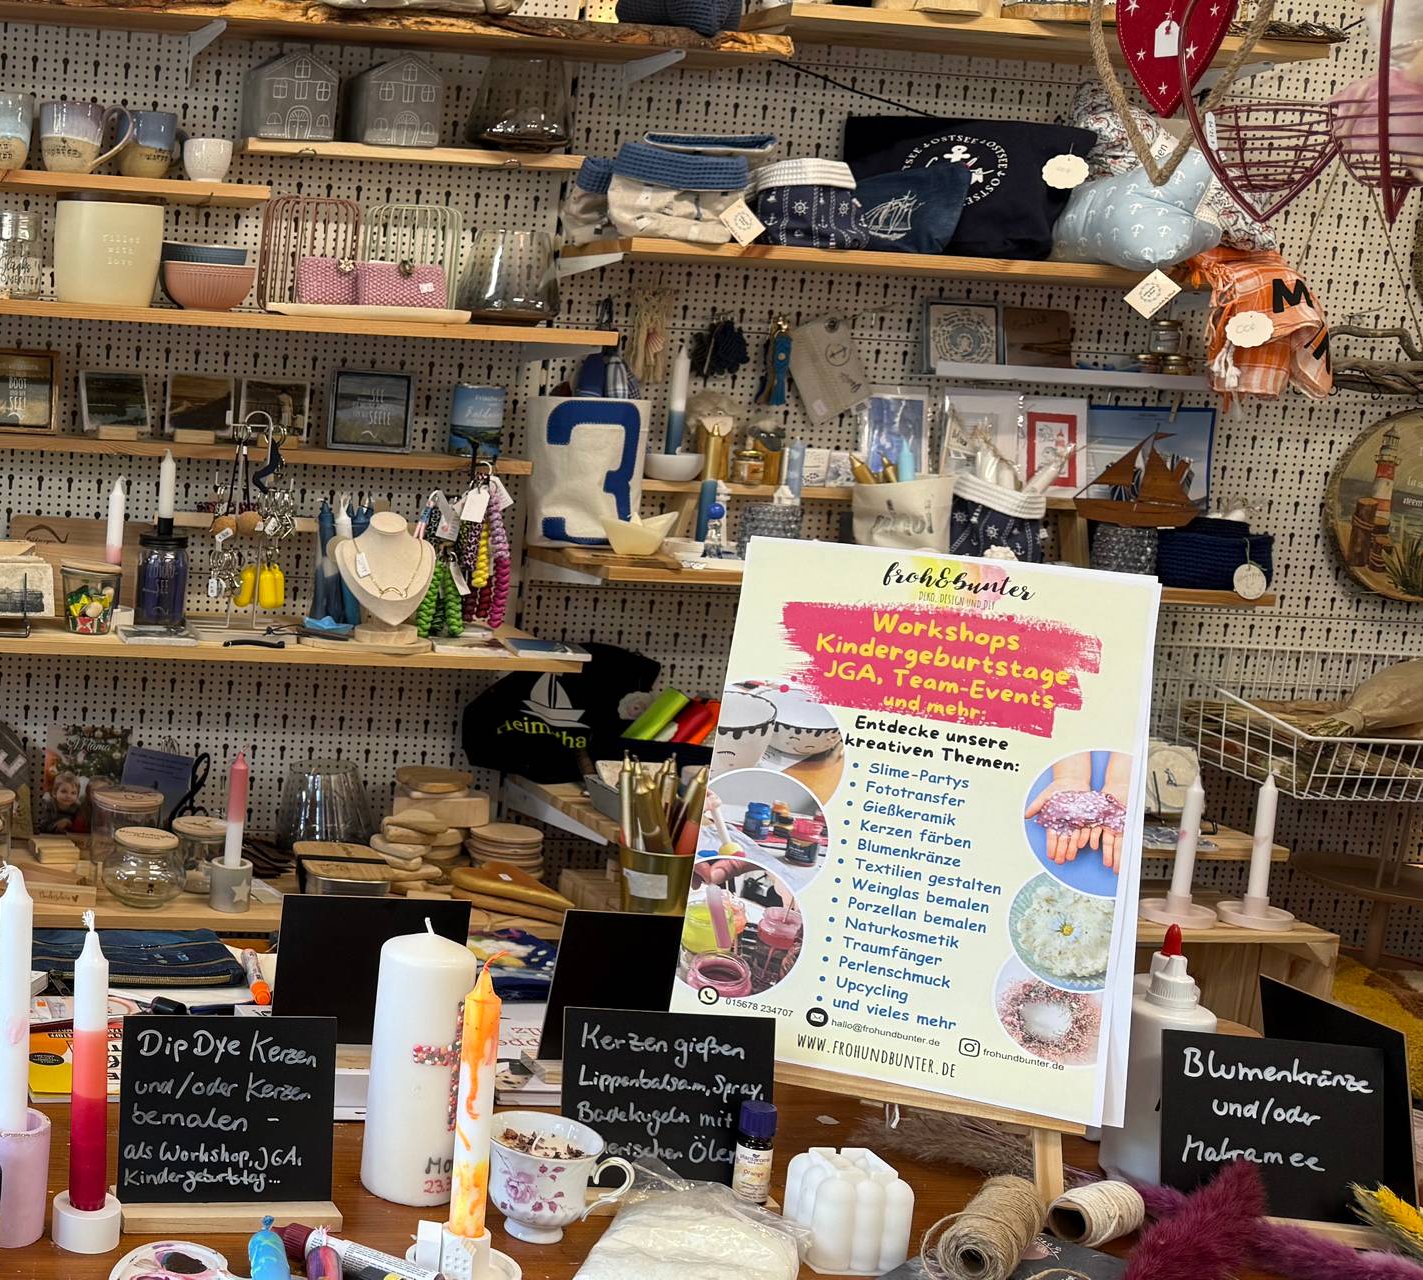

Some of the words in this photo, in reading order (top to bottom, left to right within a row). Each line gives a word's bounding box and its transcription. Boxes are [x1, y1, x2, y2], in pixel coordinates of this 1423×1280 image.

[930, 134, 979, 145] OSTSEE
[986, 141, 1009, 169] OSTSEE
[107, 257, 133, 265] love
[1272, 278, 1315, 313] M
[882, 561, 1036, 601] froh&bunter
[939, 593, 964, 605] DESIGN
[965, 597, 981, 609] UND
[982, 598, 995, 611] DIY
[873, 611, 1020, 655] Workshops
[816, 633, 1070, 690] Kindergeburtstage
[823, 660, 883, 685] JGA,
[893, 668, 1055, 710] Team-Events
[882, 694, 921, 713] und
[927, 702, 987, 720] mehr:
[496, 716, 587, 749] eimha
[854, 715, 940, 740] Entdecke
[946, 731, 1009, 751] unsere
[844, 733, 934, 759] kreativen
[942, 746, 1020, 773] Themen:
[868, 762, 970, 790] Slime-Partys
[865, 780, 966, 807] Fototransfer
[863, 800, 956, 826] Gießkeramik
[860, 819, 912, 839] Kerzen
[919, 829, 972, 849] färben
[857, 838, 961, 867] Blumenkränze
[854, 857, 922, 881] Textilien
[928, 873, 1002, 896] gestalten
[852, 876, 919, 900] Weinglas
[926, 891, 989, 914] bemalen
[848, 896, 917, 920] Porzellan
[923, 910, 987, 934] bemalen
[845, 916, 959, 949] Naturkosmetik
[843, 936, 943, 966] Traumfänger
[838, 955, 951, 989] Perlenschmuck
[836, 975, 909, 1004] Upcycling
[725, 997, 759, 1012] 015678
[760, 1003, 794, 1018] 234707
[832, 997, 860, 1012] und
[866, 1003, 910, 1022] vieles
[916, 1013, 957, 1031] mehr
[137, 1028, 187, 1063] Dip
[192, 1027, 241, 1064] Dye
[248, 1030, 317, 1068] Kerzen
[580, 1021, 669, 1055] Kerzen
[673, 1035, 745, 1069] gießen
[830, 1017, 941, 1047] hallo@frohundbunter.de
[796, 1033, 957, 1079] WWW.FROHUNDBUNTER.DE
[982, 1046, 1066, 1072] frohundbunter.de
[1183, 1046, 1374, 1094] Blumenkränze
[134, 1071, 239, 1098] und/oder
[245, 1072, 312, 1102] Kerzen
[577, 1064, 711, 1097] Lippenbalsam,
[712, 1074, 764, 1103] Spray,
[132, 1103, 248, 1133] bemalen
[576, 1100, 691, 1136] Badekugeln
[698, 1111, 733, 1129] mit
[1212, 1097, 1322, 1126] und/oder
[123, 1141, 153, 1161] als
